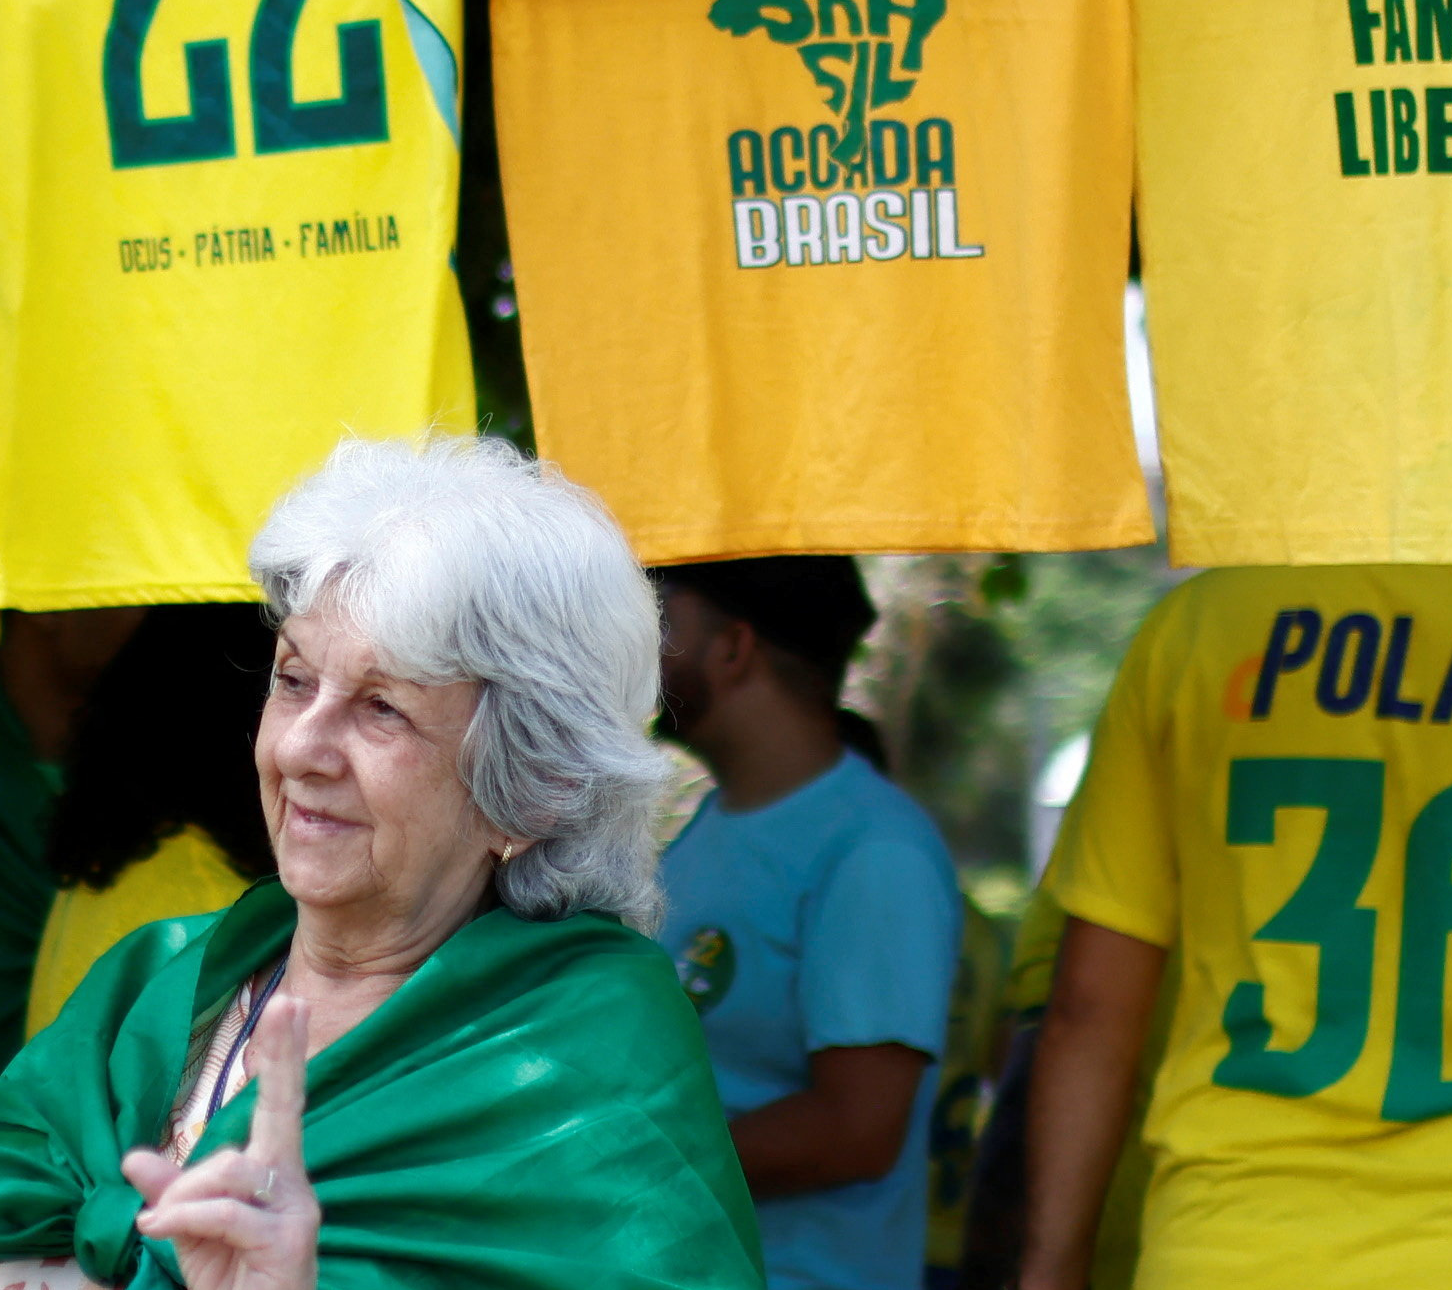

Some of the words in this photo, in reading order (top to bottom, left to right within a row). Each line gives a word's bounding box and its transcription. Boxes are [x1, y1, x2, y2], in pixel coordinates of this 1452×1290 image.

[119, 236, 172, 273] DEUS
[194, 225, 275, 267] PÁTRIA
[299, 212, 400, 254] FAMÍLIA
[732, 188, 985, 269] BRASIL
